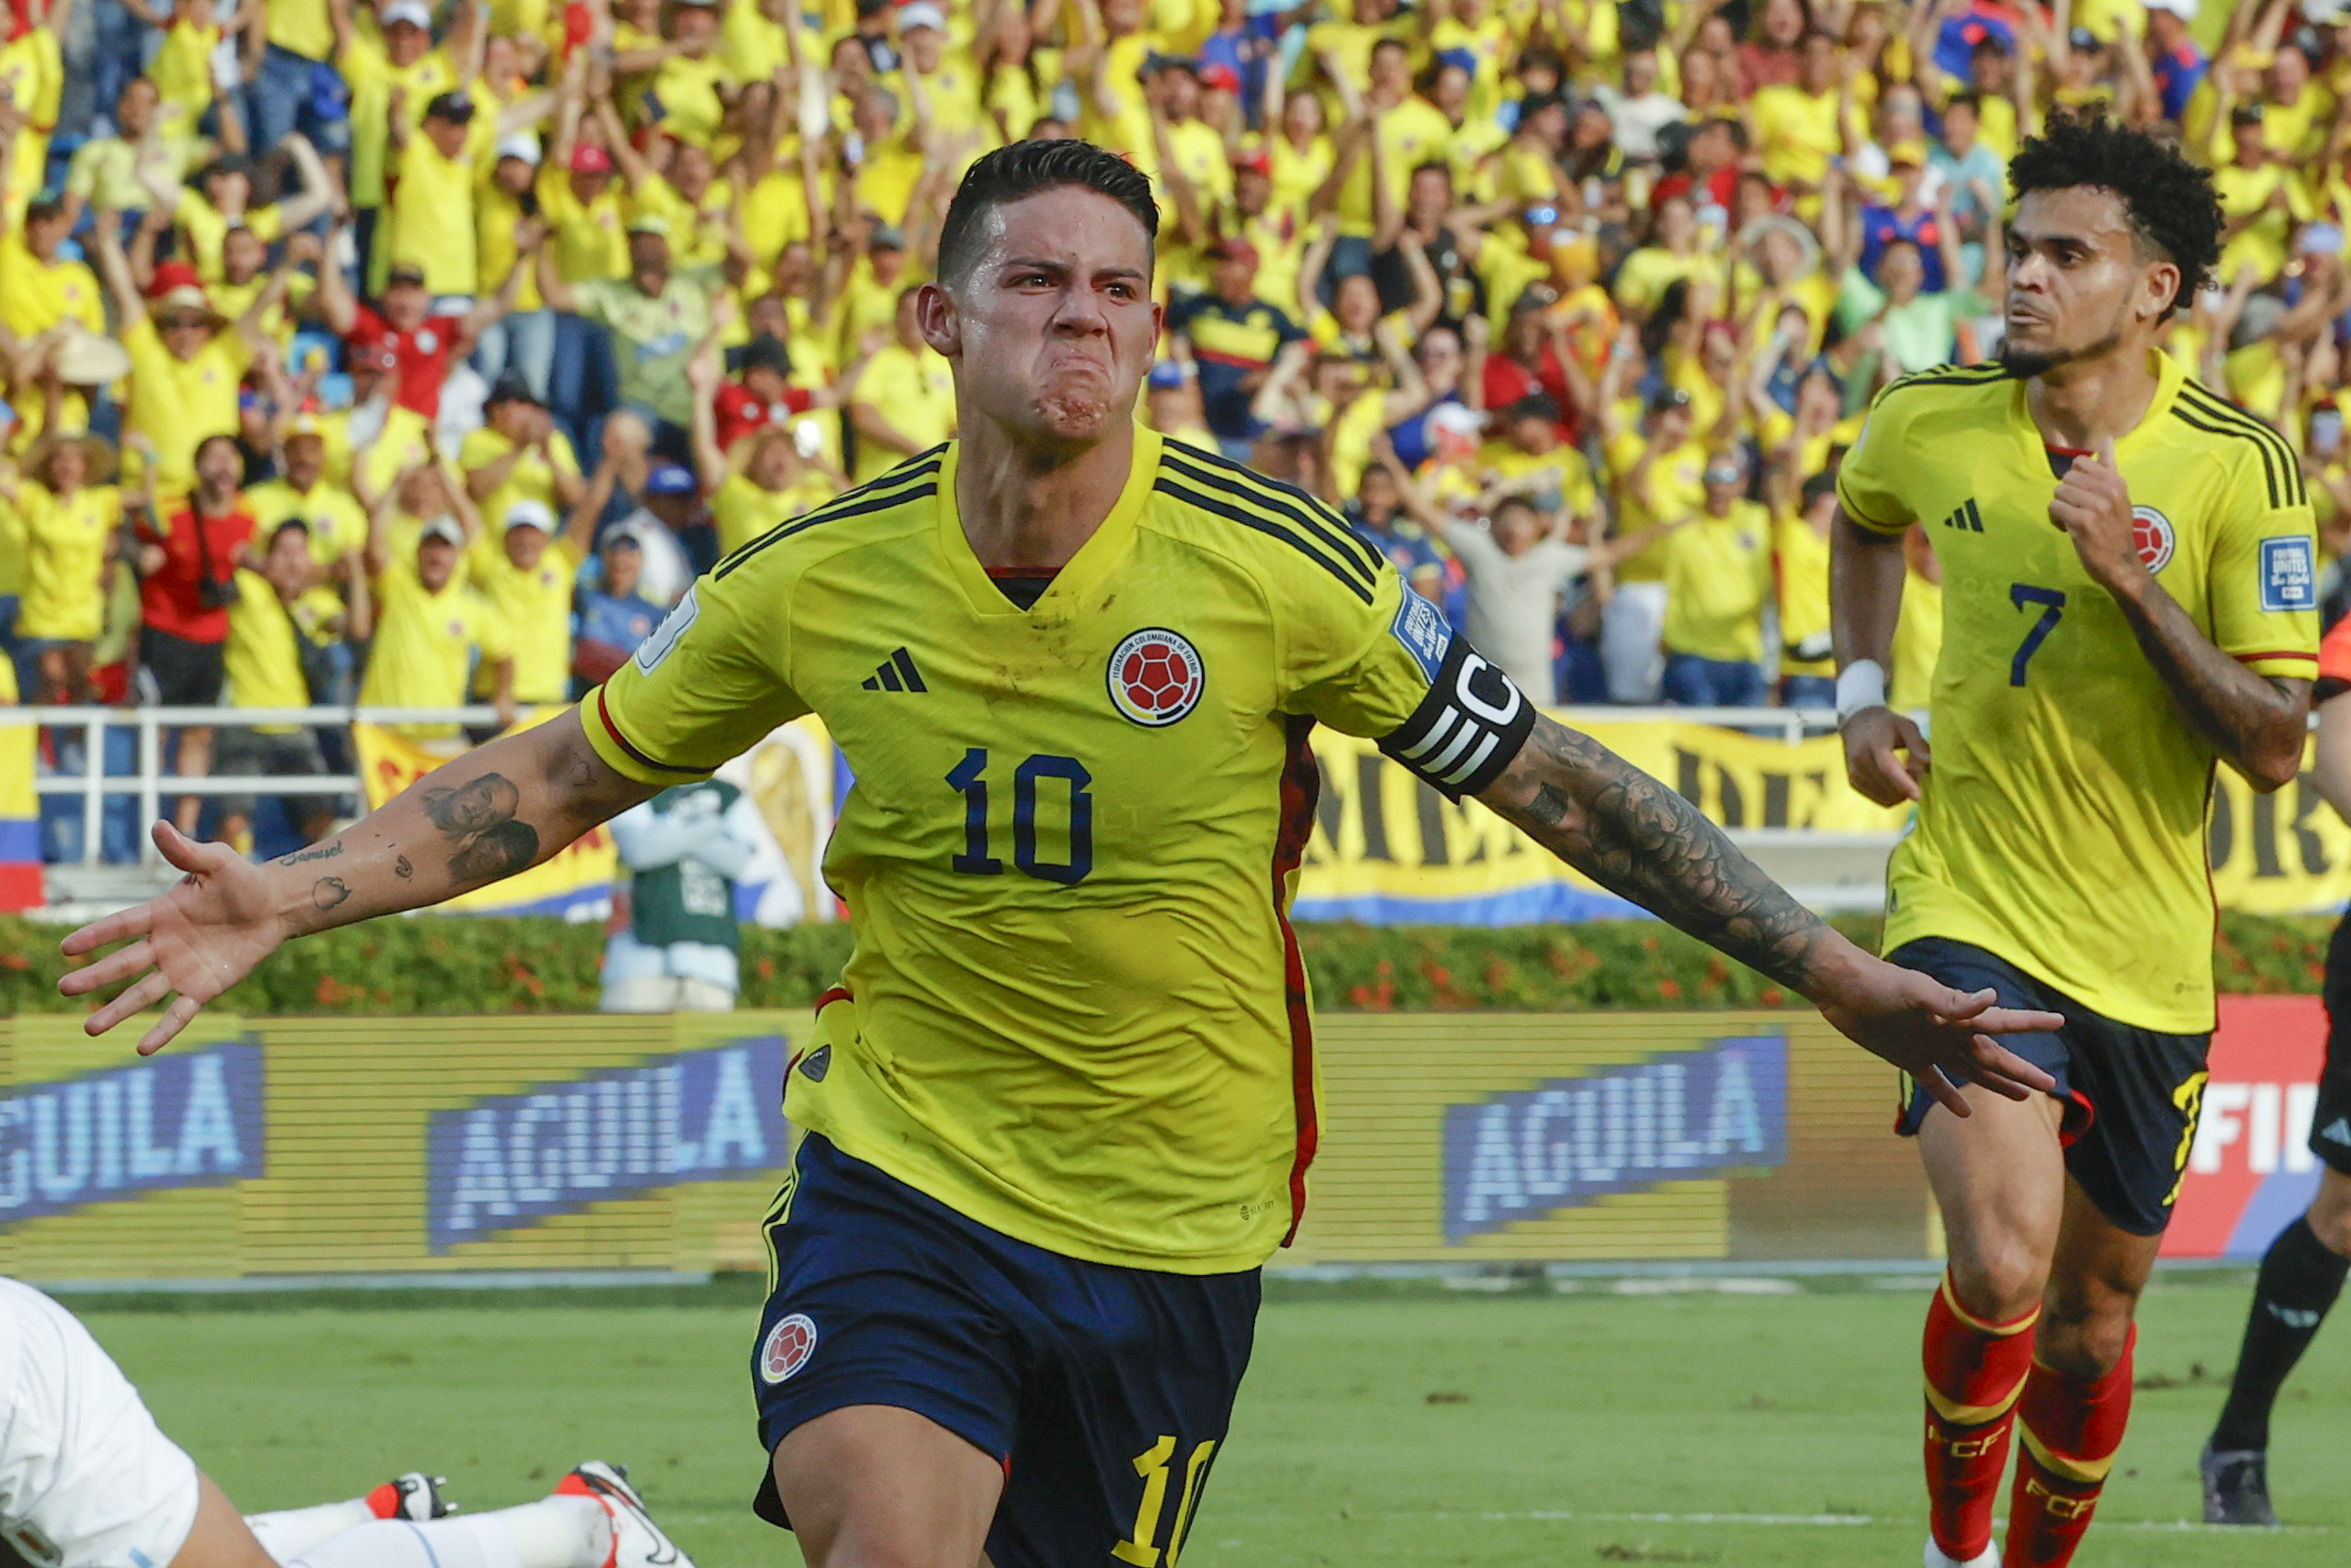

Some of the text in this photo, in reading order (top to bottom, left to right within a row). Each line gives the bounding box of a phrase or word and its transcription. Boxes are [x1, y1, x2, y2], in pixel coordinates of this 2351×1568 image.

[1456, 653, 1521, 727] C
[2010, 583, 2065, 687] 7
[945, 747, 1092, 885] 10
[447, 1049, 768, 1229] AGUILA
[1464, 1049, 1764, 1221] AGUILA
[2025, 1477, 2097, 1520] FCF
